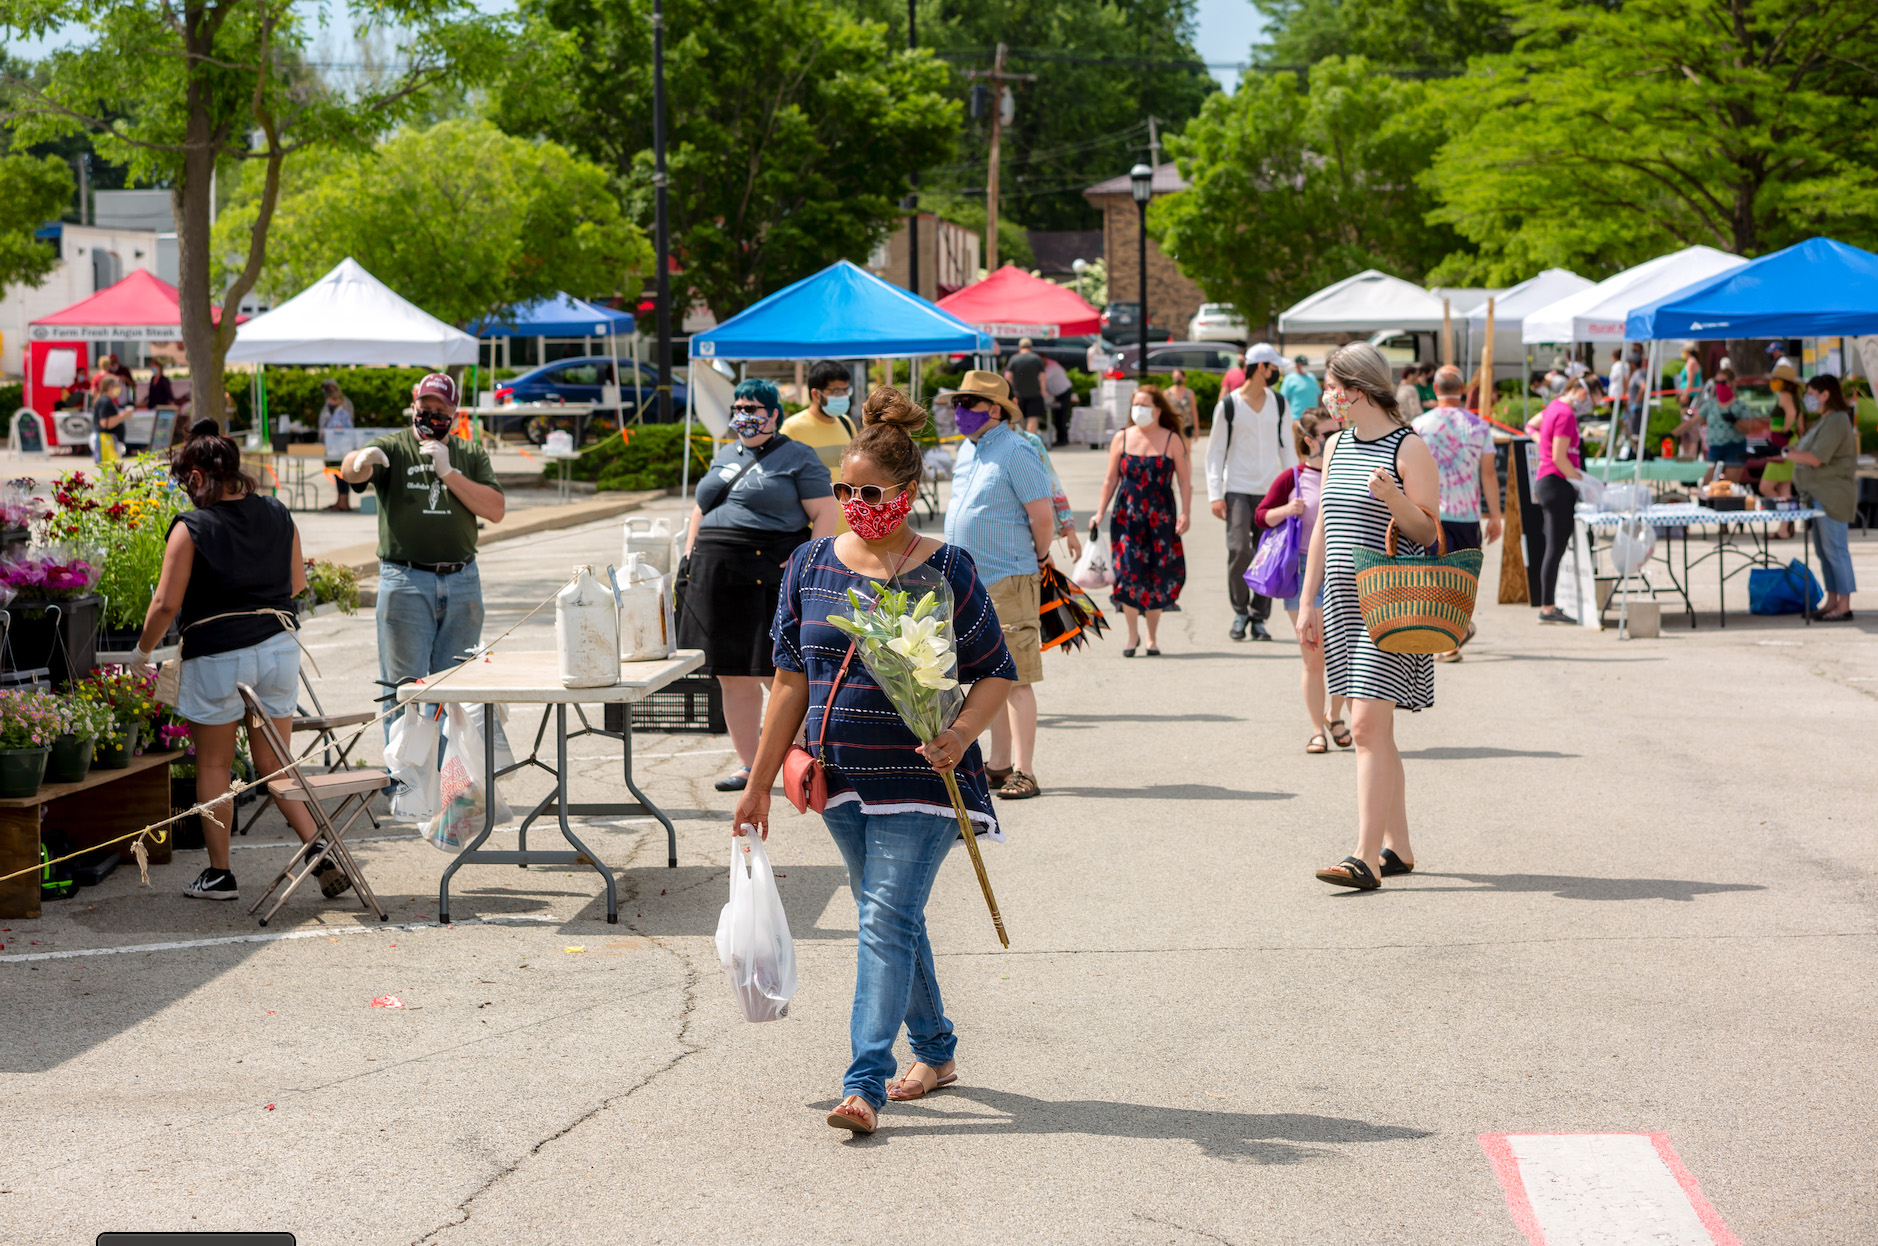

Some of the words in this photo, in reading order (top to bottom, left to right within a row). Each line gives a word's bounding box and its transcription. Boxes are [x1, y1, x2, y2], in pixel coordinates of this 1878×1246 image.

[53, 328, 78, 337] Farm
[82, 328, 109, 337] Fresh
[112, 328, 143, 338] Angus
[146, 328, 174, 337] Steak
